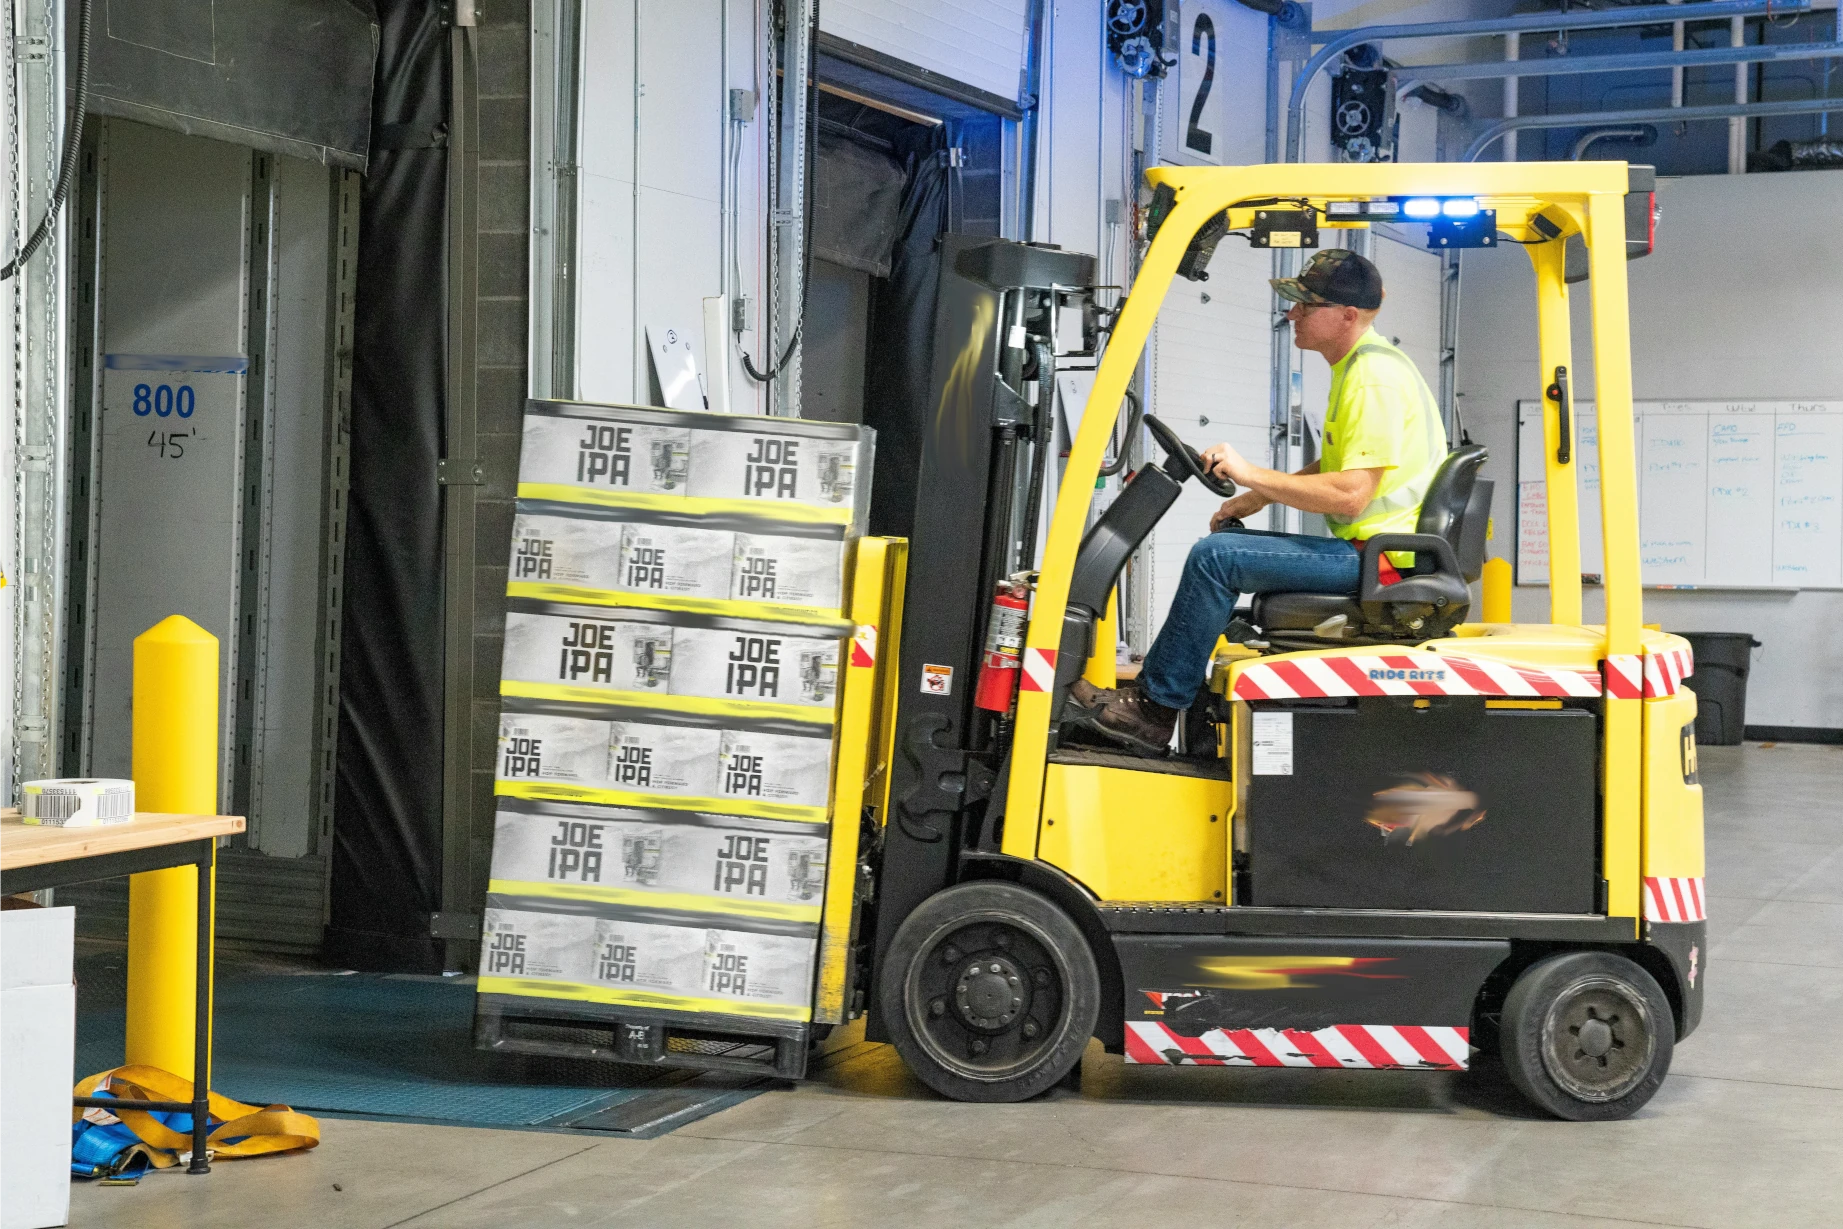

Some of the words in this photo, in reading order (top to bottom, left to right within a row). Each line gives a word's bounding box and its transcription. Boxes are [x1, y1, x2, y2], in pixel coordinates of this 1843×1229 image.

[1186, 13, 1216, 155] 2
[133, 383, 195, 418] 800
[1789, 403, 1827, 412] Thurs
[148, 426, 196, 458] 45'
[580, 425, 632, 452] JOE
[747, 439, 799, 466] JOE
[578, 451, 630, 485] IPA
[745, 465, 797, 498] IPA
[518, 539, 553, 557] JOE
[630, 548, 665, 566] JOE
[516, 556, 552, 579] IPA
[628, 565, 664, 588] IPA
[742, 557, 777, 576] JOE
[740, 575, 776, 598] IPA
[563, 623, 615, 650] JOE
[729, 637, 781, 664] JOE
[560, 649, 614, 683] IPA
[1369, 669, 1405, 680] RIDE
[726, 663, 780, 697] IPA
[507, 738, 542, 756] JOE
[617, 746, 652, 765] JOE
[504, 756, 541, 777] IPA
[616, 764, 651, 786] IPA
[728, 755, 763, 773] JOE
[726, 772, 762, 796] IPA
[552, 821, 605, 849] JOE
[718, 835, 770, 862] JOE
[548, 848, 602, 882] IPA
[714, 860, 767, 895] IPA
[491, 933, 526, 952] JOE
[601, 944, 636, 963] JOE
[489, 951, 525, 974] IPA
[599, 962, 635, 982] IPA
[712, 954, 748, 973] JOE
[710, 972, 746, 995] IPA
